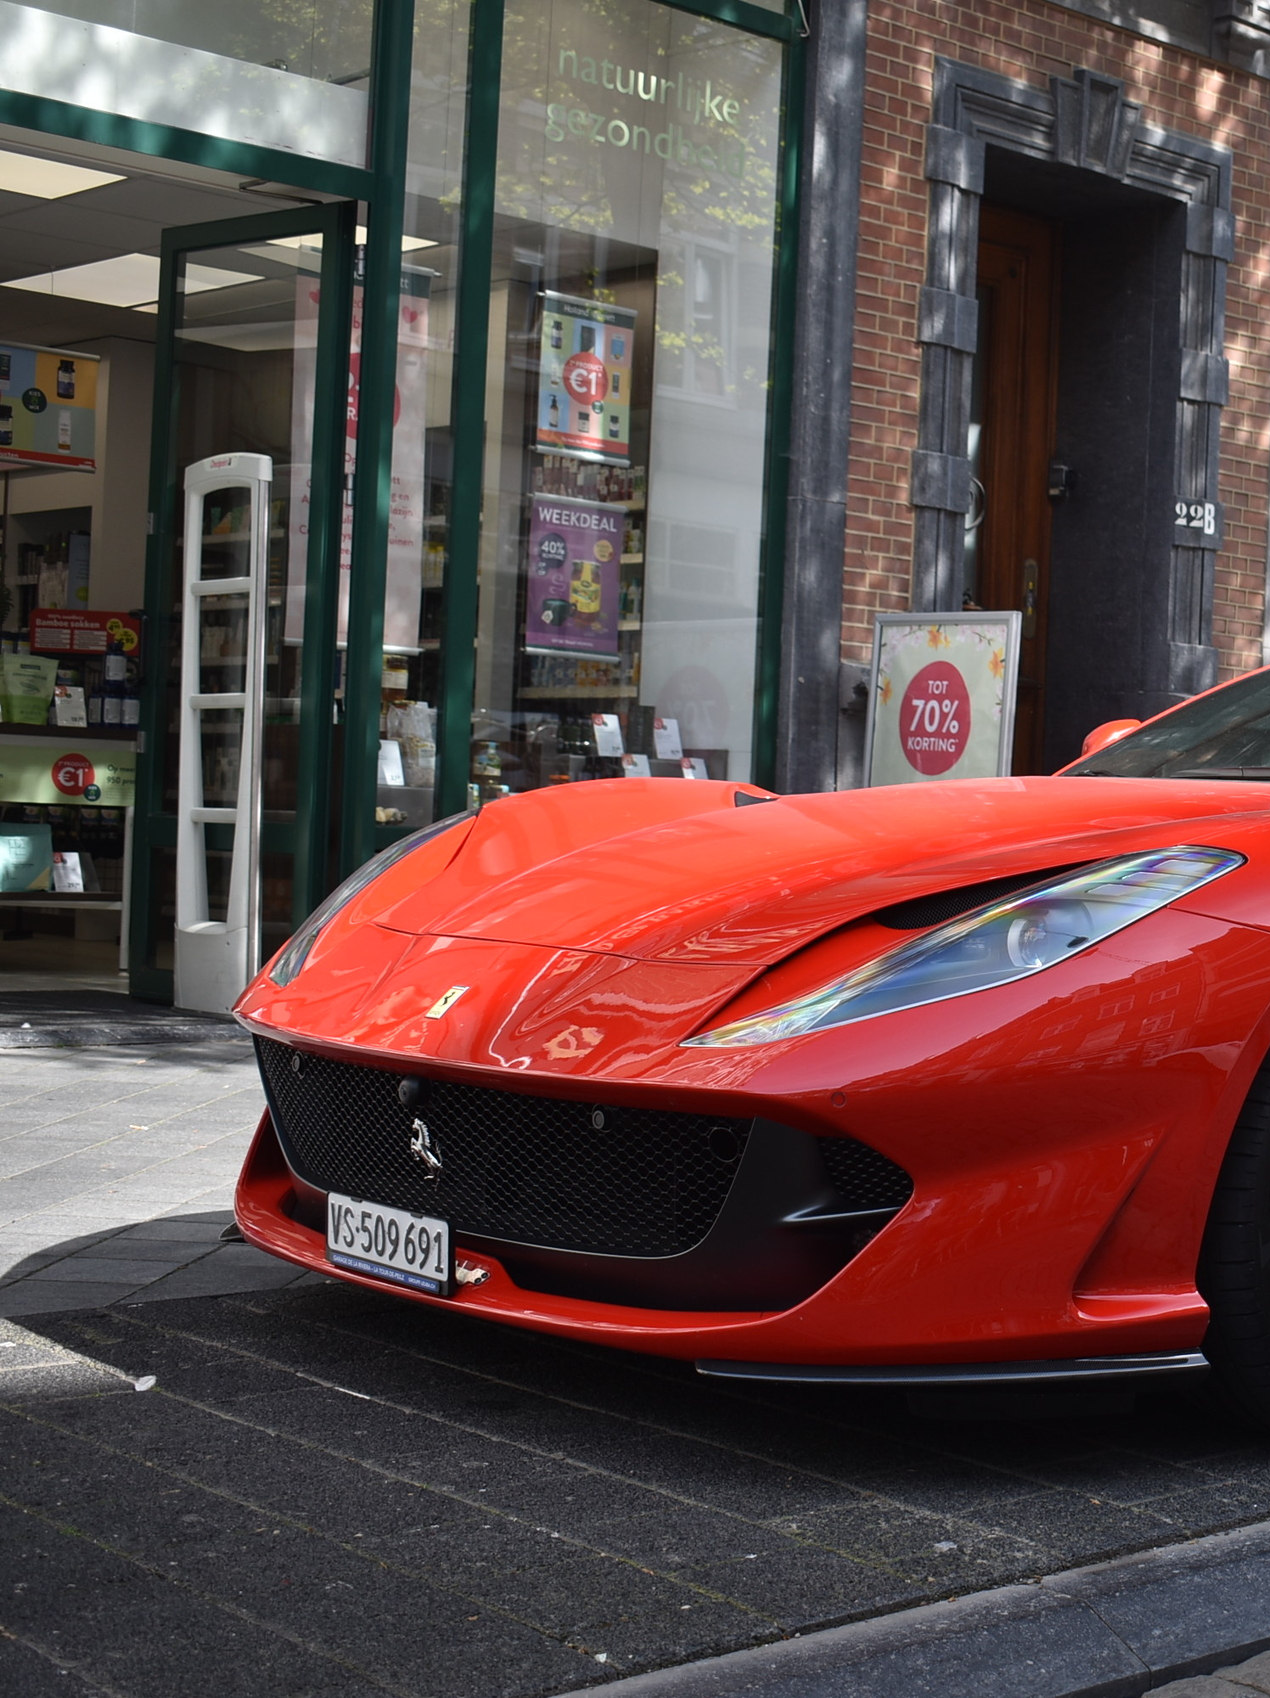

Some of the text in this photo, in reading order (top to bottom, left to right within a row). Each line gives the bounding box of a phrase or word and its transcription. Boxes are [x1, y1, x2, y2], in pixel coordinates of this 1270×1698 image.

[559, 49, 740, 125] natuurlijke
[545, 103, 746, 178] gezondheid
[538, 506, 618, 533] WEEKDEAL
[1174, 502, 1216, 535] 22B
[540, 540, 566, 555] 40%
[35, 618, 101, 629] Bamboe sokken
[927, 680, 949, 695] TOT
[909, 699, 959, 734] 70%
[404, 1222, 444, 1274] 691
